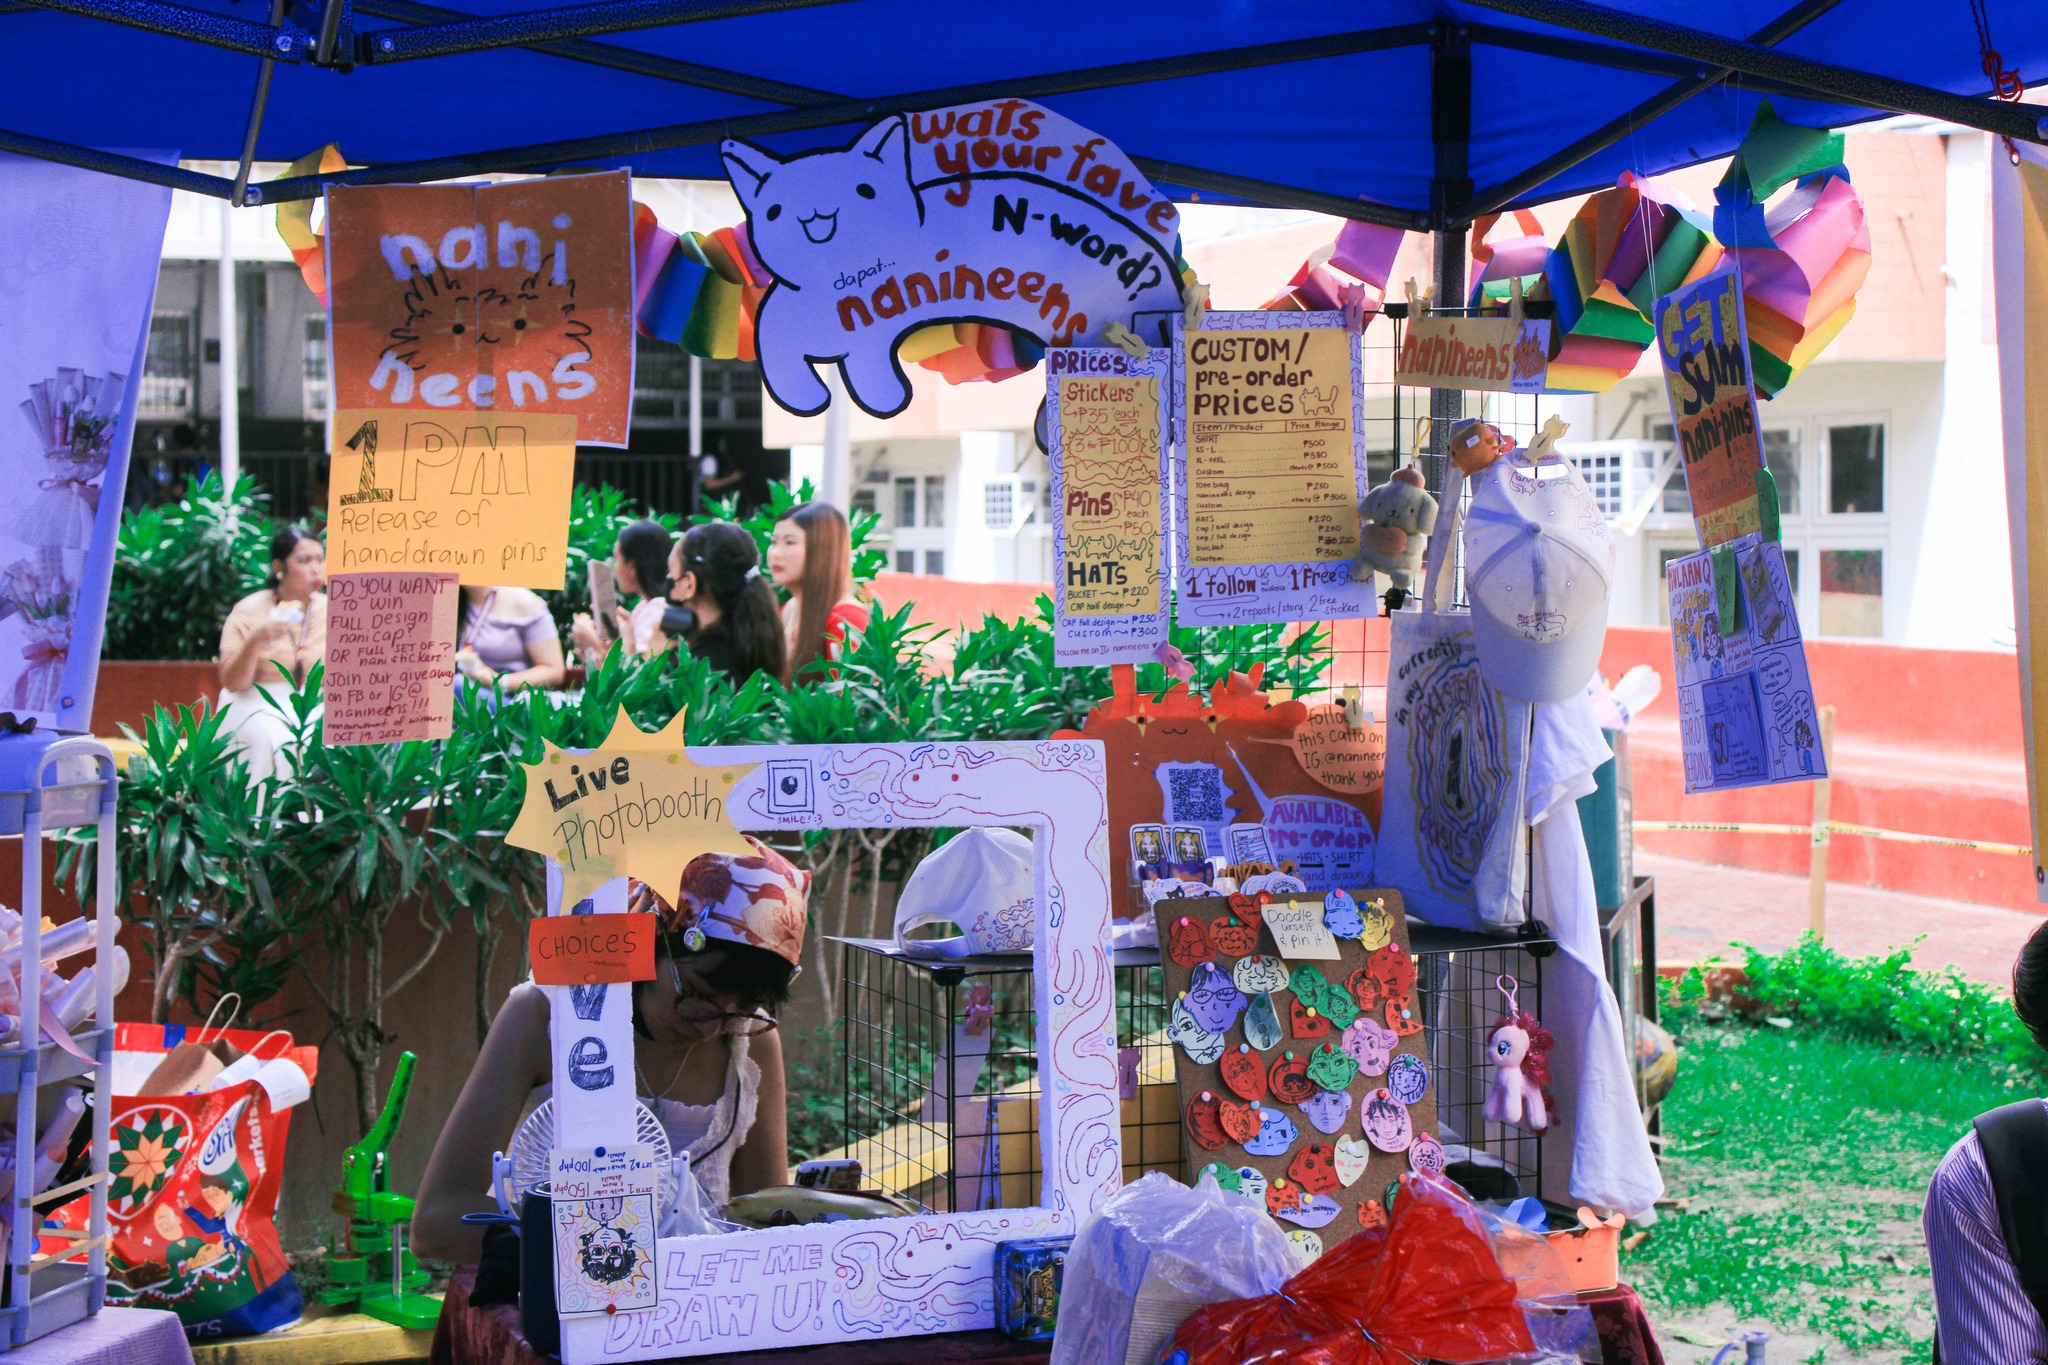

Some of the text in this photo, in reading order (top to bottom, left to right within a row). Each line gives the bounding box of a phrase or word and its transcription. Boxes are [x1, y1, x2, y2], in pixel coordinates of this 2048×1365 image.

[910, 100, 1045, 144] wats
[934, 138, 1177, 234] your fave
[380, 213, 573, 286] nani
[992, 193, 1162, 302] N-word?
[836, 248, 1088, 348] nanineens
[1656, 274, 1733, 373] GET
[1401, 324, 1511, 380] nanineens
[369, 351, 597, 407] neens
[1195, 363, 1313, 391] pre-order
[1290, 420, 1310, 430] Price
[1314, 419, 1340, 431] Range
[1074, 438, 1085, 453] 3
[339, 420, 530, 506] 1 PM
[340, 499, 492, 534] Release of
[1126, 509, 1149, 518] each
[342, 539, 548, 571] handdrawn pins
[330, 580, 355, 601] DO
[400, 578, 454, 595] WANT
[1067, 589, 1098, 600] BUCKET
[1186, 576, 1202, 597] 1
[1205, 575, 1256, 597] follow
[1303, 568, 1337, 589] Free
[1070, 600, 1125, 613] CAP half design
[1309, 594, 1318, 612] 2
[1319, 595, 1338, 606] free
[330, 612, 428, 631] FULL Design
[1061, 617, 1077, 627] CAP
[1091, 616, 1117, 631] design
[339, 630, 370, 644] nani
[330, 641, 435, 664] OR FULL SET OF
[359, 655, 388, 667] nani
[368, 672, 393, 685] our
[400, 669, 455, 690] giveaway
[327, 682, 422, 707] on FB or IG @
[1405, 680, 1425, 707] my
[393, 715, 405, 727] of
[333, 732, 355, 742] OCT
[1298, 731, 1325, 749] this
[1369, 732, 1384, 744] on
[544, 757, 630, 812] Live
[1321, 770, 1357, 785] thank
[553, 777, 721, 872] Photobooth
[1269, 802, 1363, 828] AVAILABLE
[1267, 909, 1314, 924] Doodle
[1281, 923, 1313, 932] urself
[1291, 934, 1310, 949] pin
[665, 1243, 824, 1290] LET ME
[603, 1295, 760, 1355] DRAW
